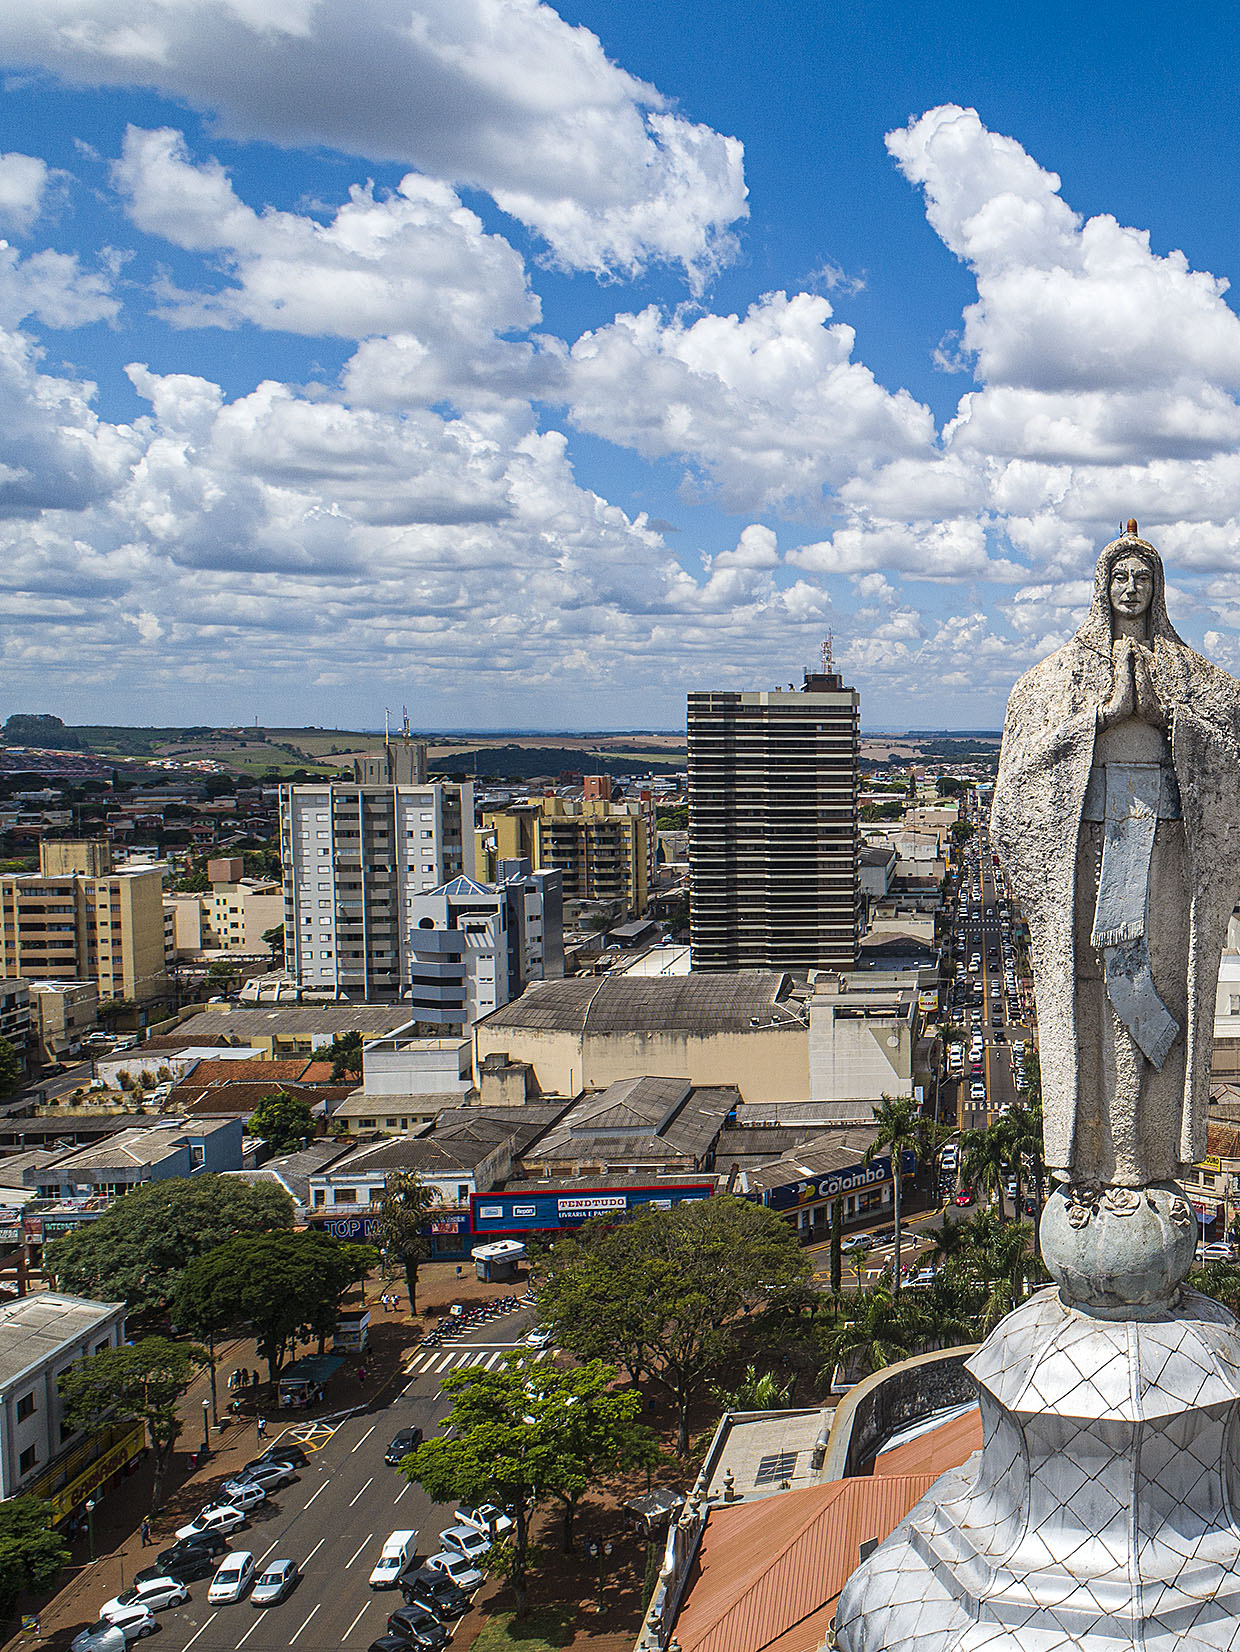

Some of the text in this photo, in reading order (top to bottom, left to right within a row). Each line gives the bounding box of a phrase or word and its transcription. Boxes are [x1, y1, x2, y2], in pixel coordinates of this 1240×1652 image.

[818, 1168, 885, 1197] Colombo
[559, 1198, 625, 1208] TENDTUDO
[324, 1219, 361, 1238] TOP
